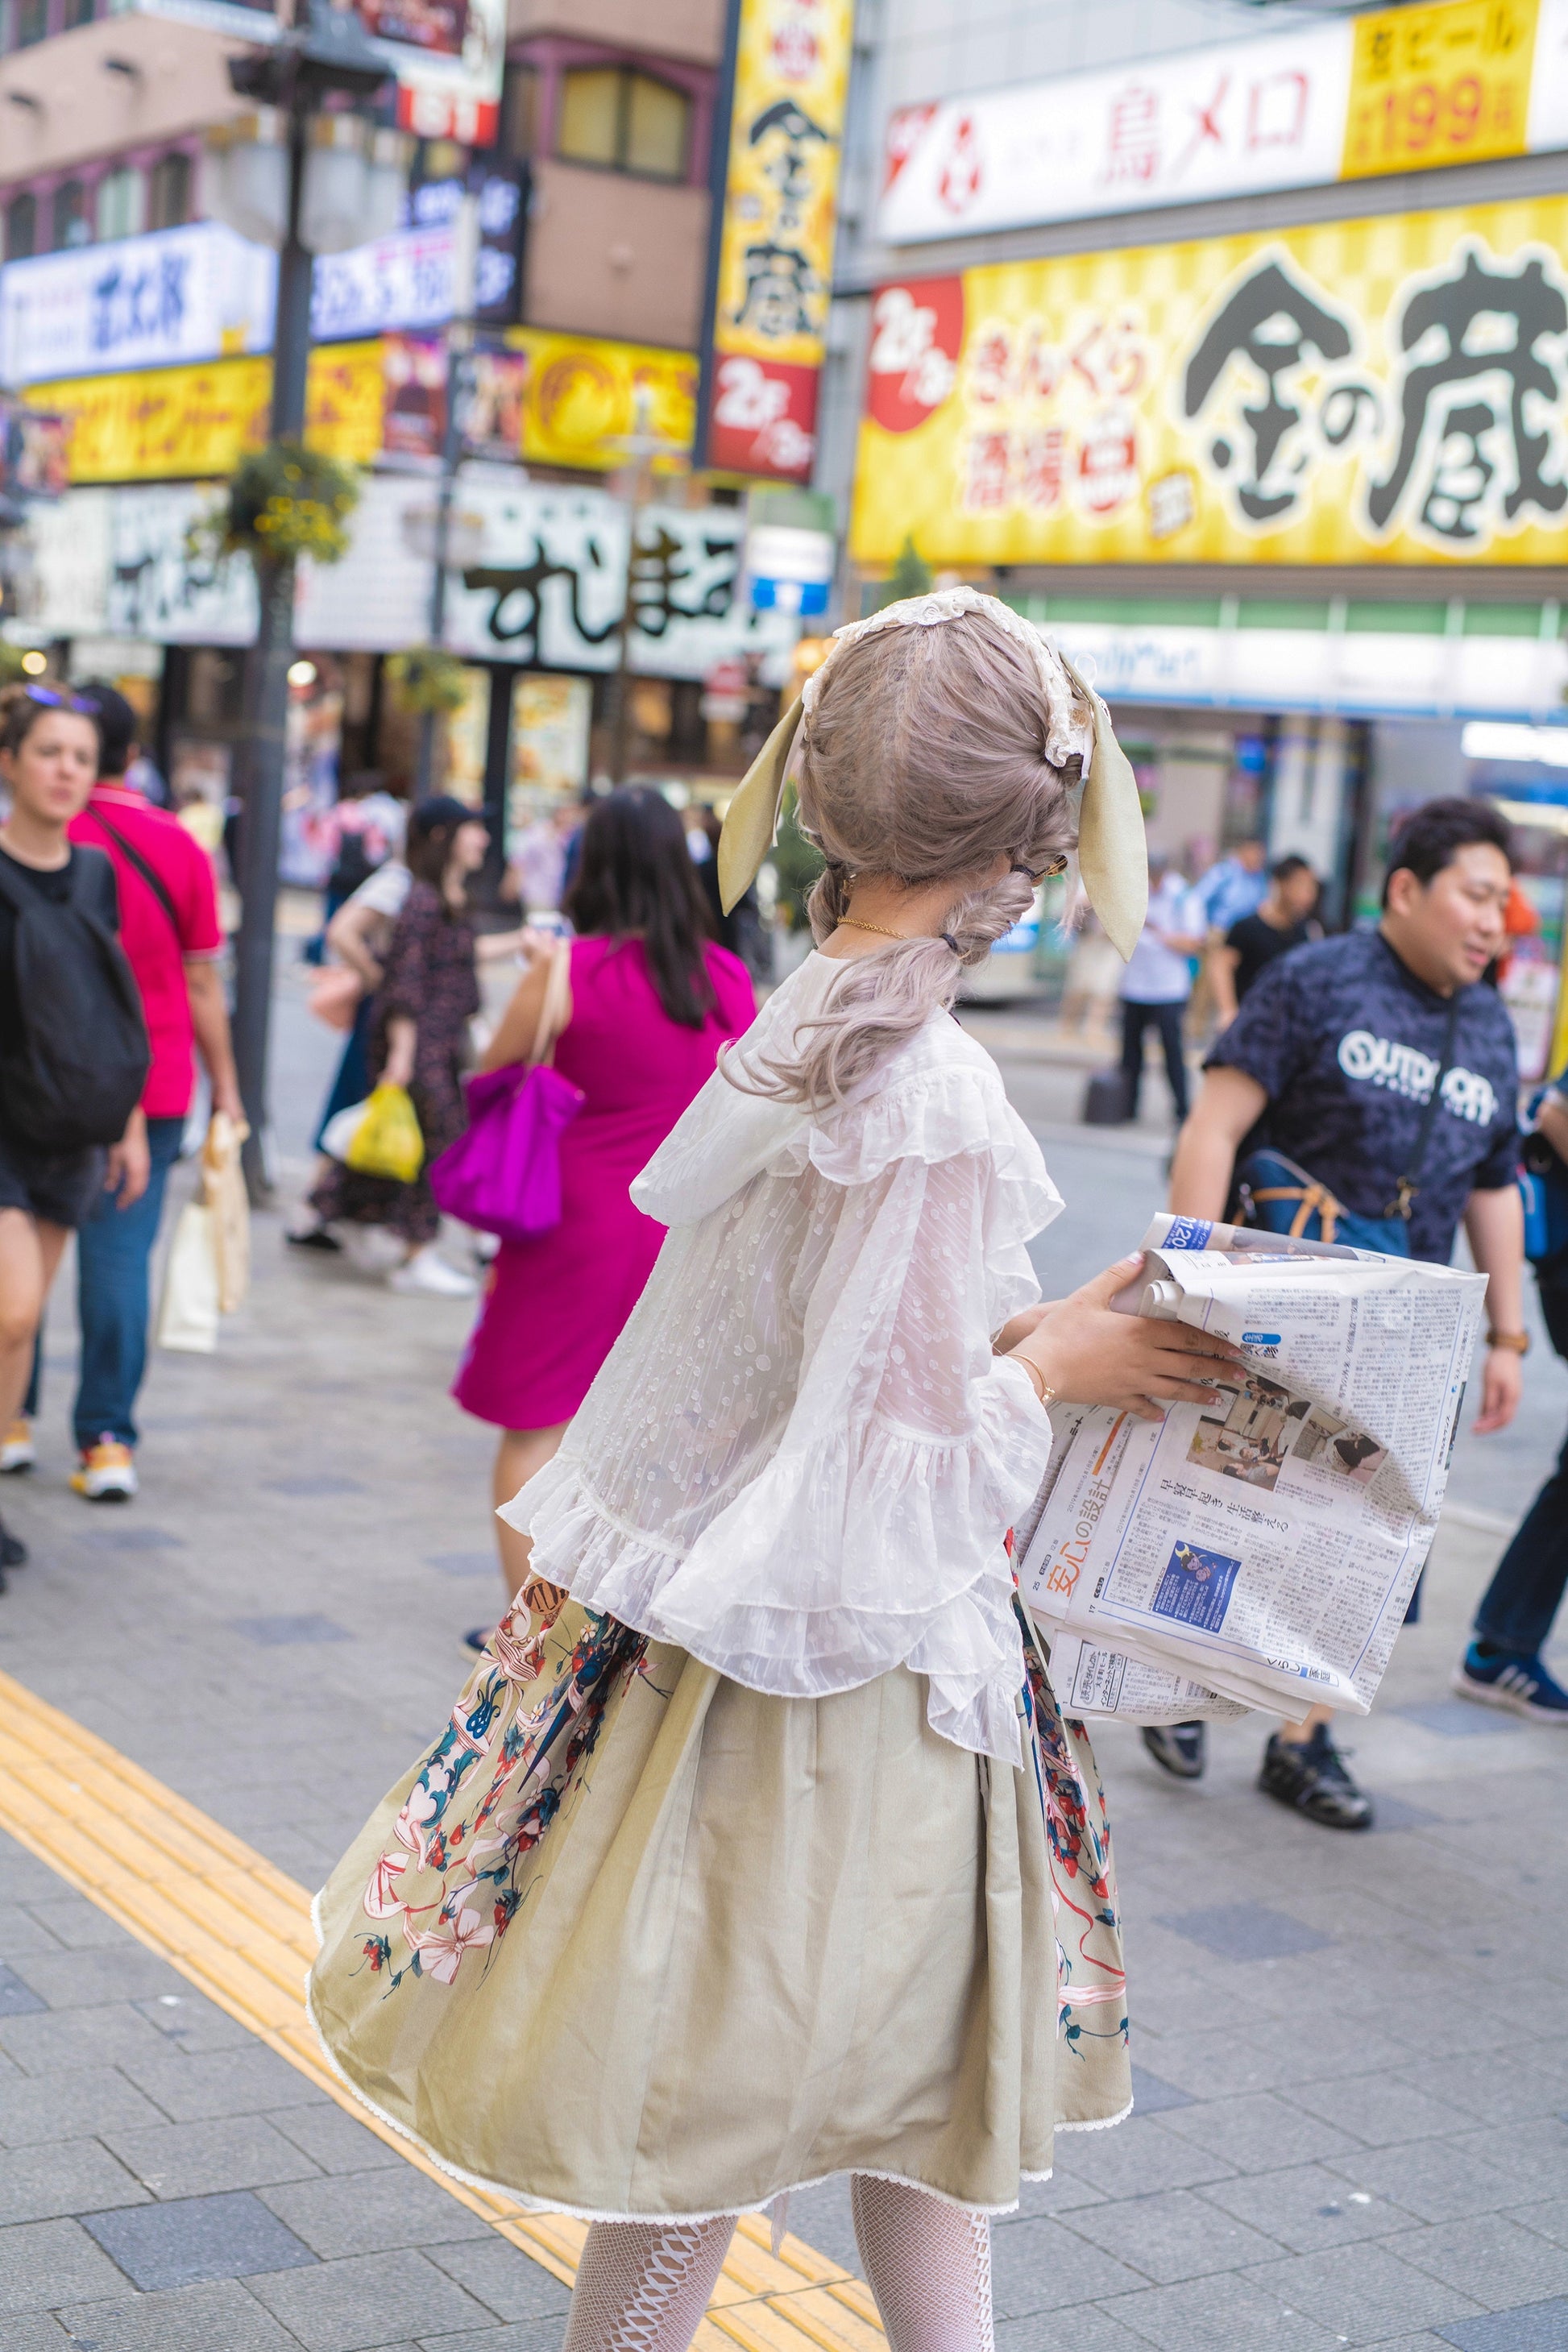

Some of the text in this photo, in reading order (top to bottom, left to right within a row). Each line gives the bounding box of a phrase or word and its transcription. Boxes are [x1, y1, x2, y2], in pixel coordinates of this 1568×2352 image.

[1184, 259, 1568, 541] 金の蔵
[1160, 1479, 1288, 1533] 早寝早起き 生活整える
[1047, 1479, 1111, 1597] 安心の設計
[1032, 1581, 1041, 1591] 25
[1096, 1651, 1108, 1689] 大手町モール
[1267, 1656, 1300, 1673] くらし
